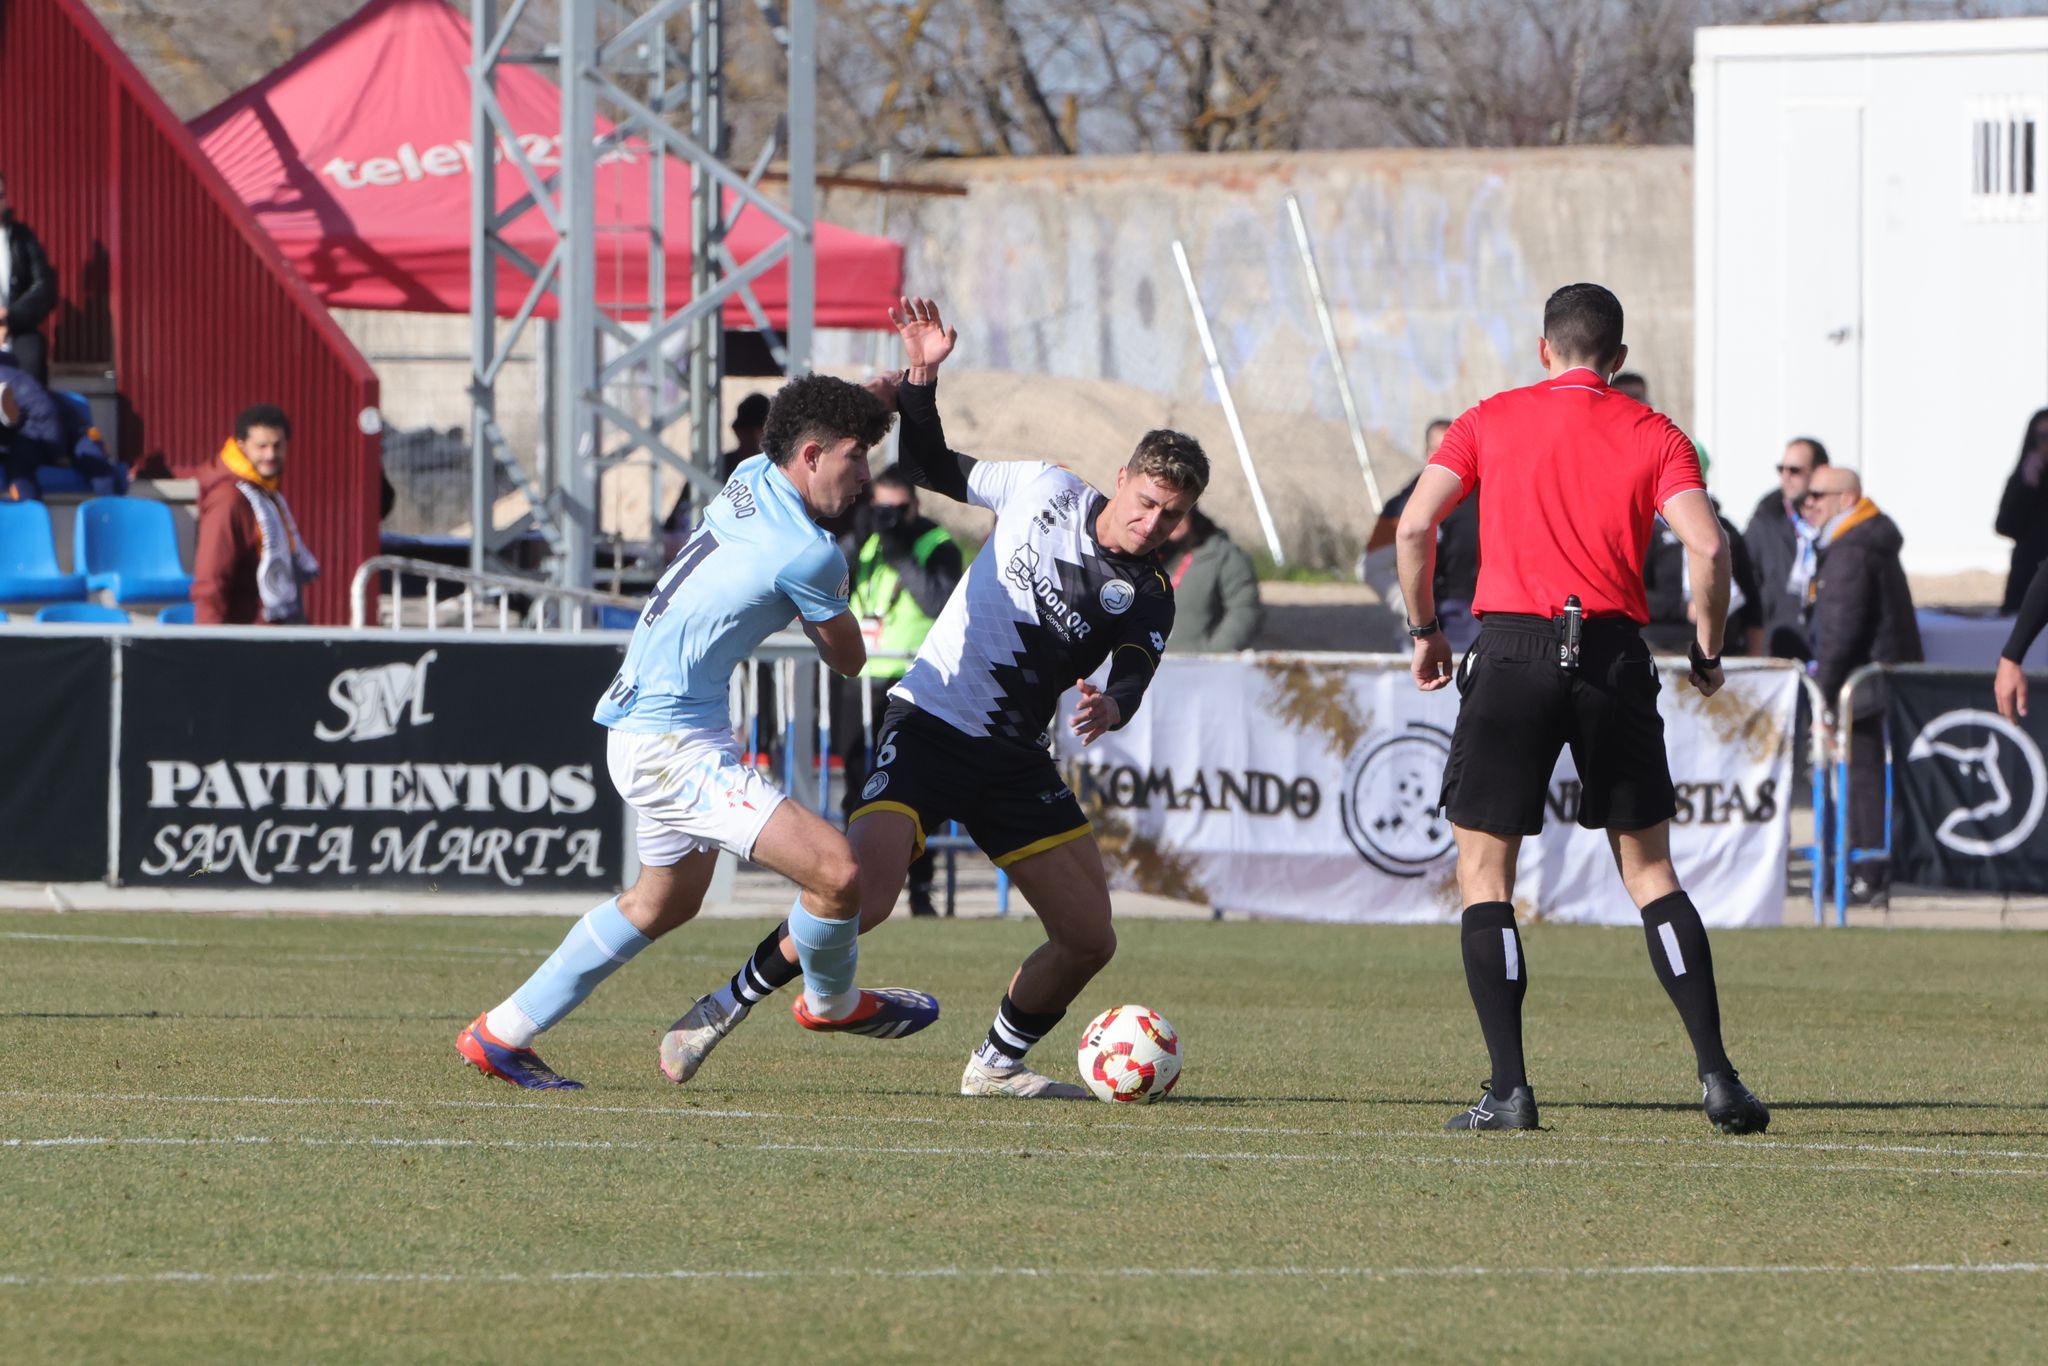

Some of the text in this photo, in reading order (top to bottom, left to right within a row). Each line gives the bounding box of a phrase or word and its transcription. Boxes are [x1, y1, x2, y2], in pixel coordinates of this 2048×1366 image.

[322, 133, 639, 189] telepiz
[645, 517, 720, 628] 4
[1034, 576, 1091, 639] Don QR
[876, 730, 899, 768] 6
[146, 759, 598, 815] PAVIMENTOS
[1077, 763, 1322, 819] KOMANDO
[140, 819, 607, 887] SANTA MARTA
